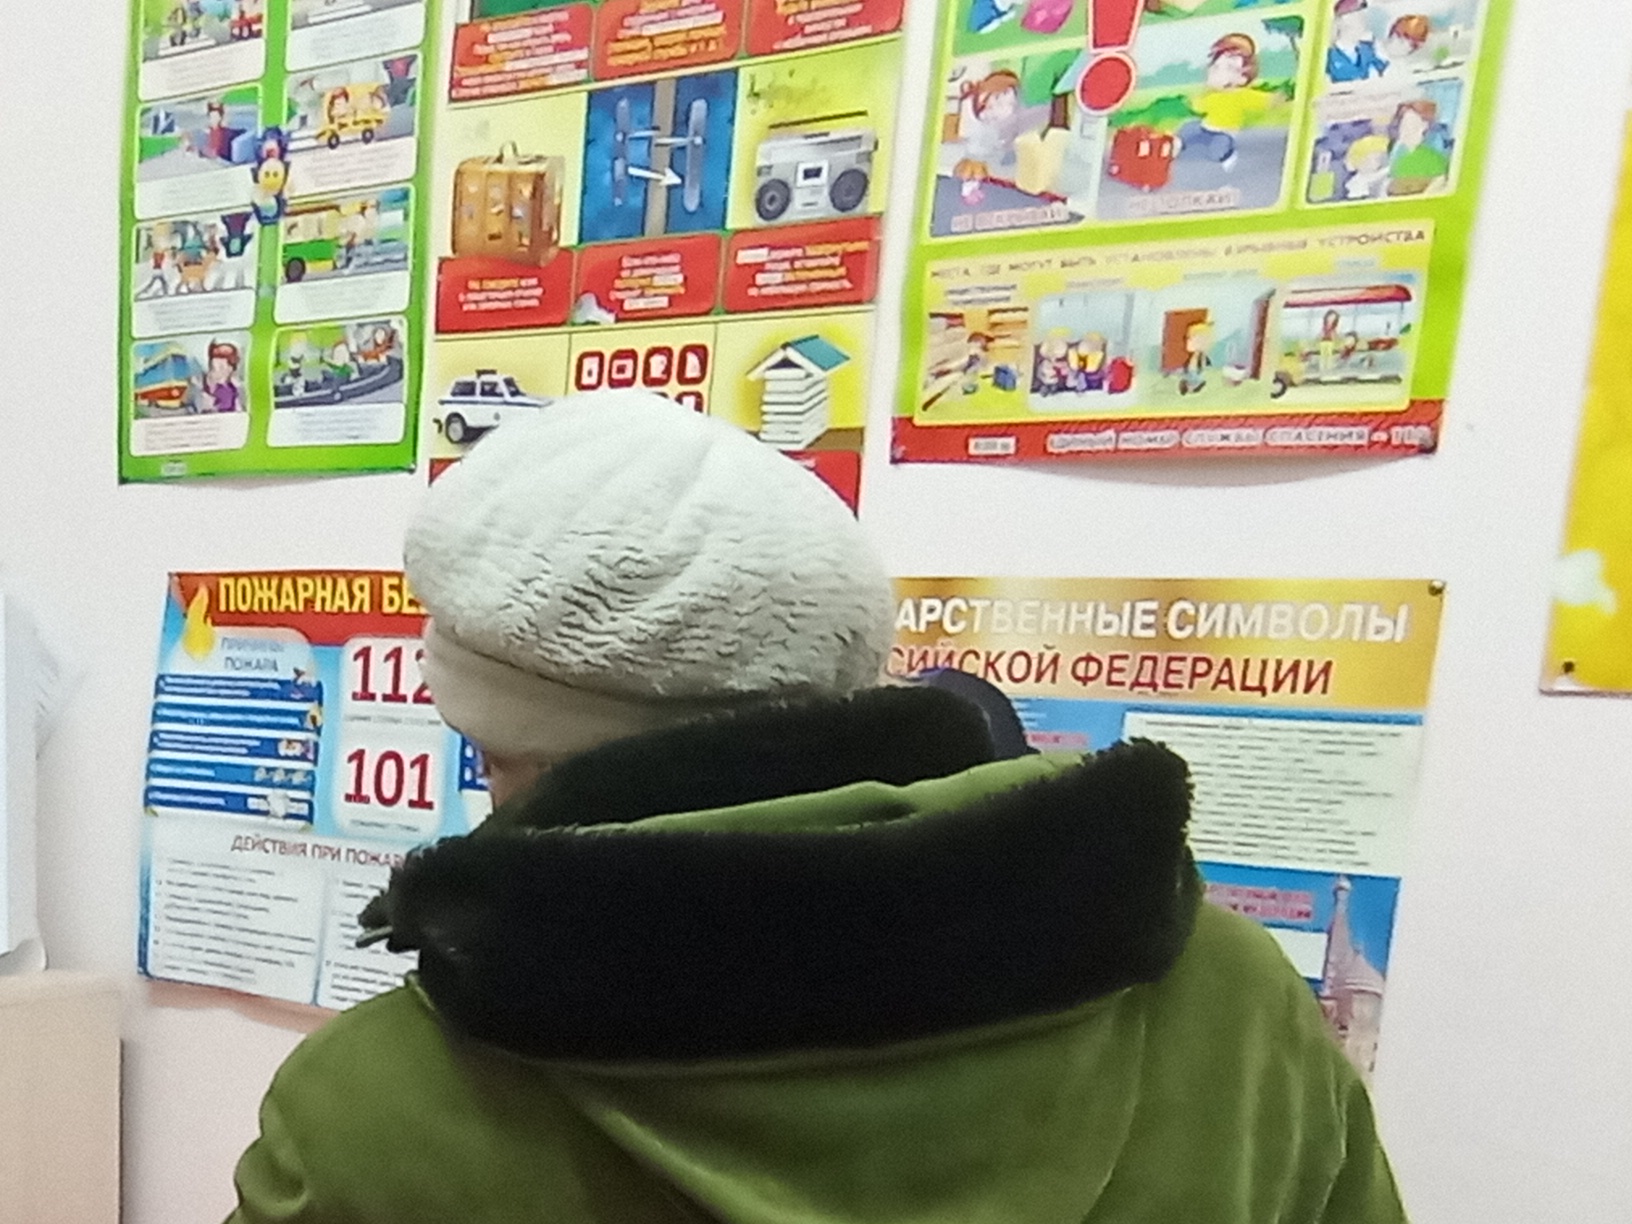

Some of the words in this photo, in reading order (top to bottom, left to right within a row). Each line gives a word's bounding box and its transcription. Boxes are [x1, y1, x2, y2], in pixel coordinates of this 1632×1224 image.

[218, 576, 370, 614] ПОЖАРНАЯ
[381, 577, 431, 615] БЕ
[894, 598, 1159, 640] АРСТВЕННЫЕ
[1167, 601, 1410, 643] СИМВОЛЫ
[886, 642, 1062, 684] СИЙСКОЙ
[1070, 652, 1333, 697] ФЕДЕРАЦИИ
[344, 748, 435, 811] 101
[231, 834, 308, 856] ДЕЙСТВИЯ
[311, 842, 342, 861] ПРИ
[345, 847, 405, 869] ПОЖАР
